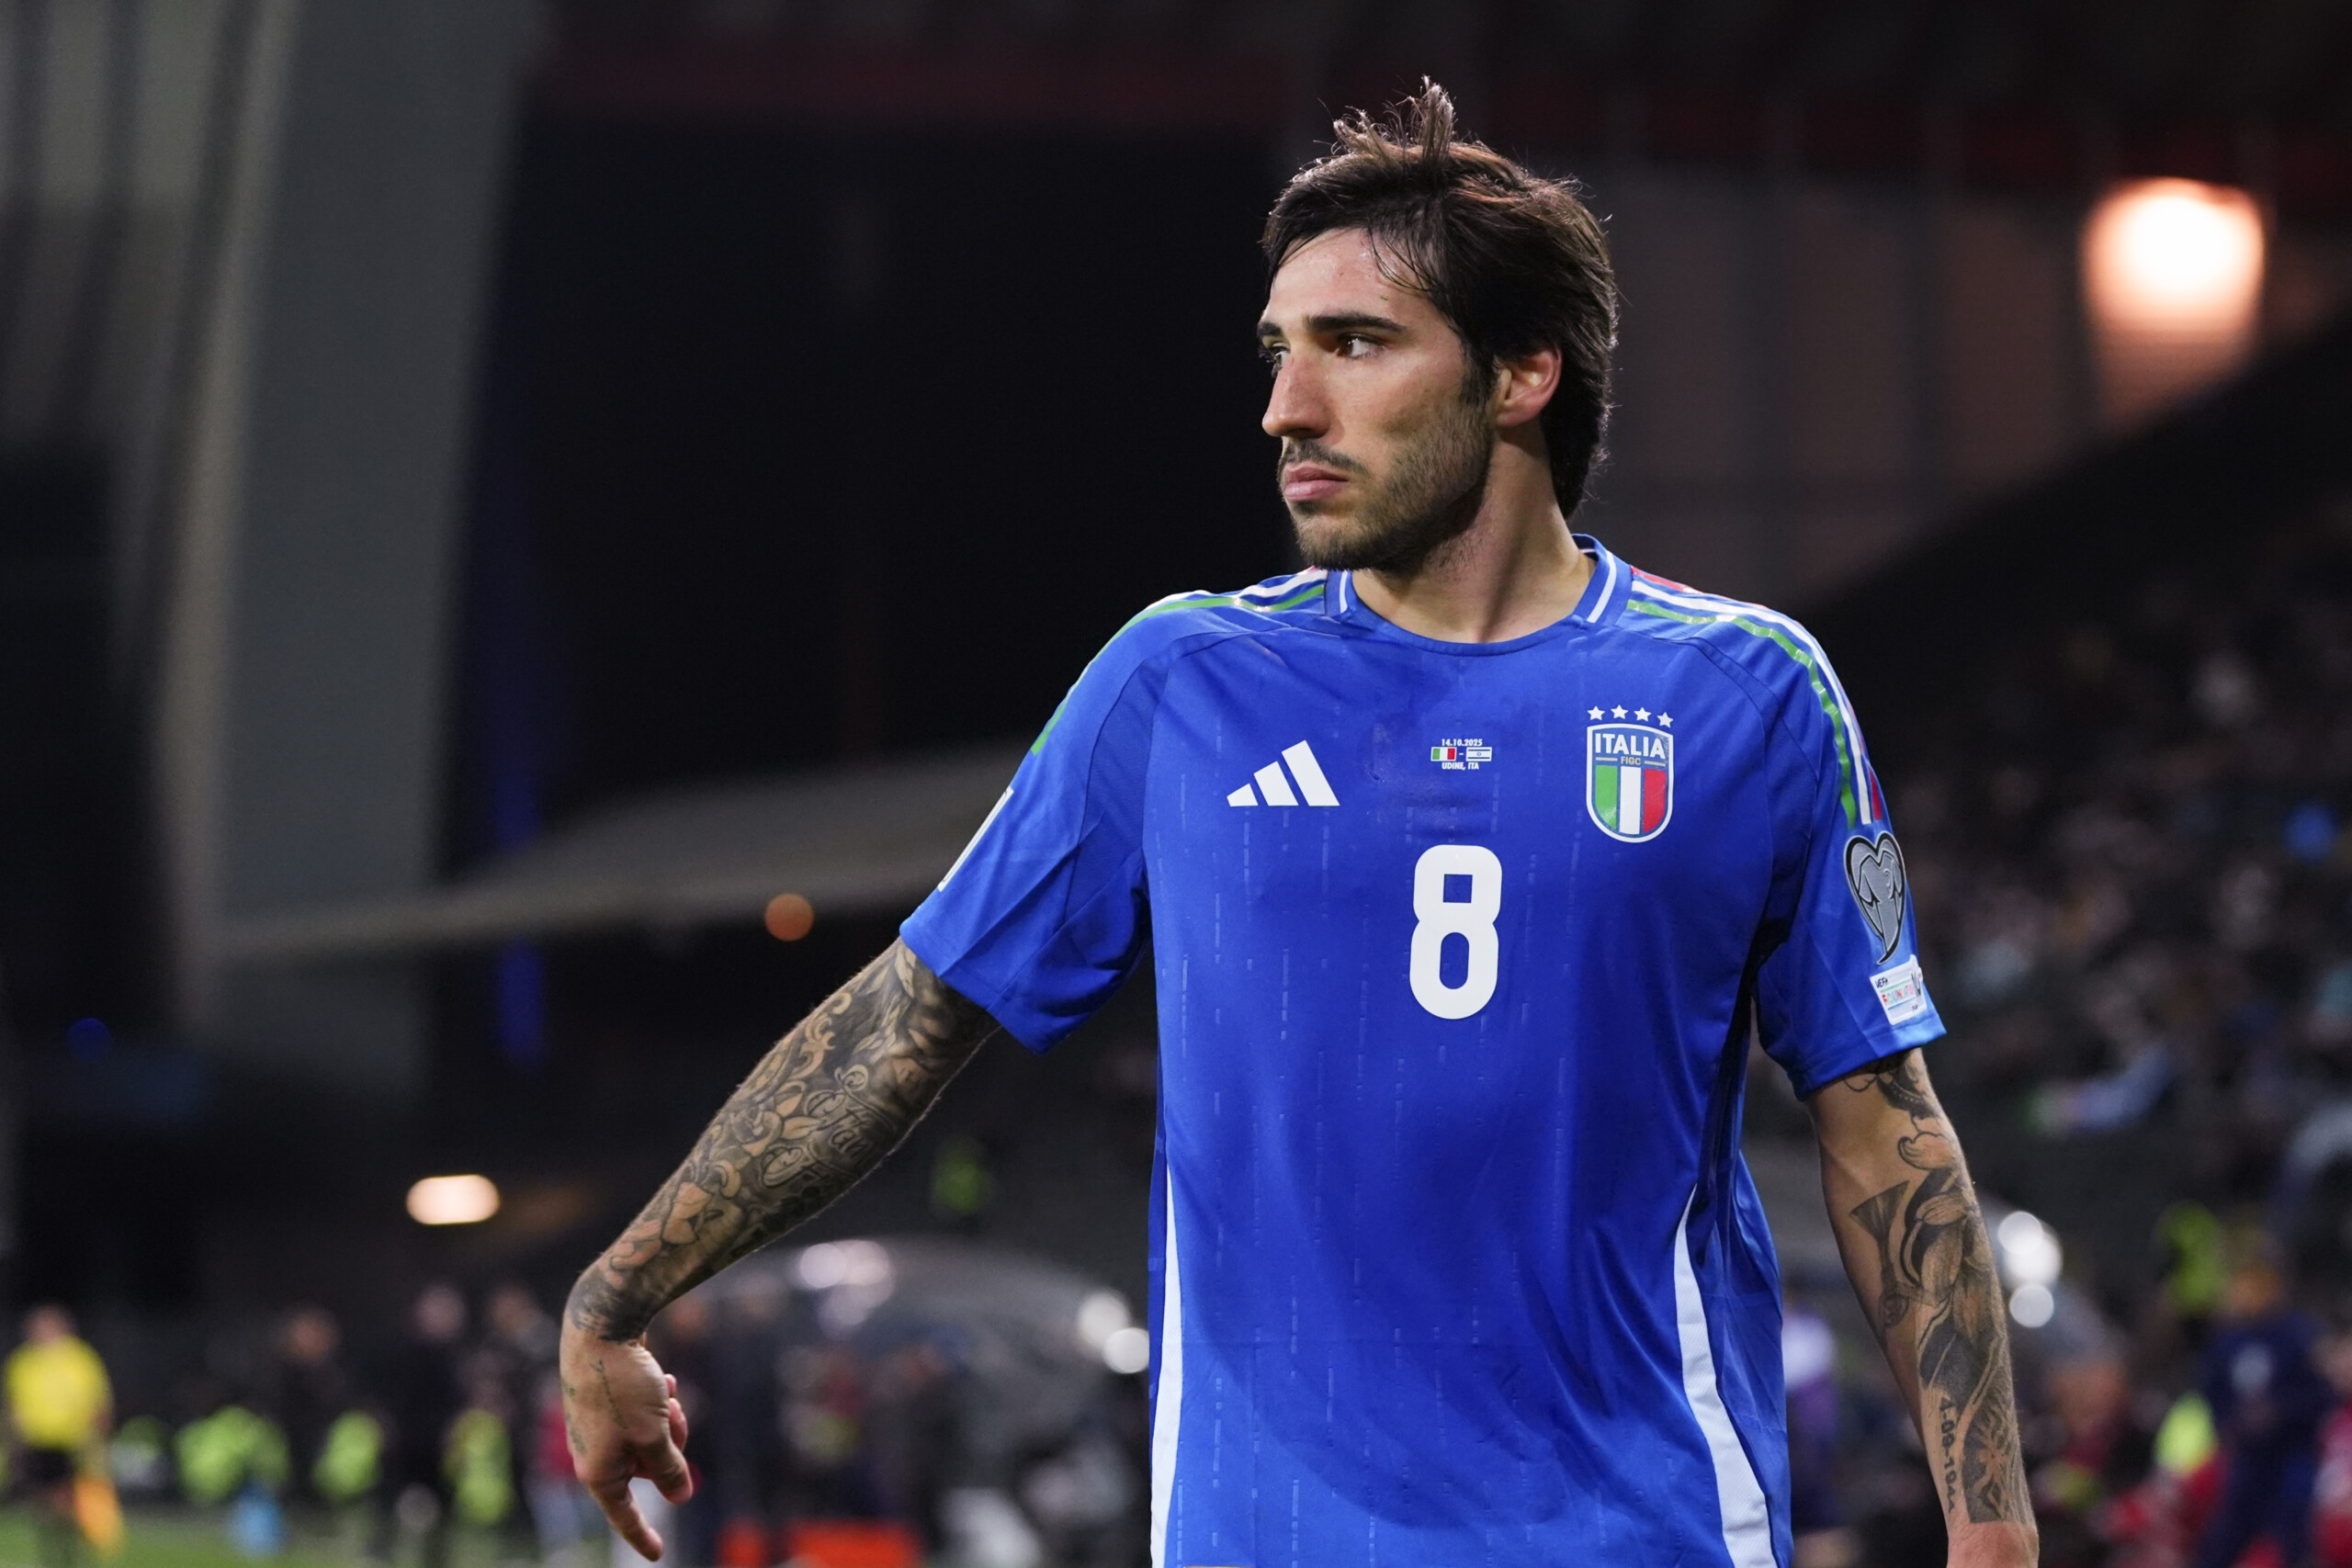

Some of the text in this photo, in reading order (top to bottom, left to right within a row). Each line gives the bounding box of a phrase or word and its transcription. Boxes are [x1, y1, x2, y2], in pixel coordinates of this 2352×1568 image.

[1442, 739, 1483, 747] 14.10.2025
[1595, 733, 1667, 760] ITALIA
[1442, 761, 1465, 771] UDINE,
[1621, 756, 1642, 766] FIGC
[1409, 844, 1503, 1021] 8
